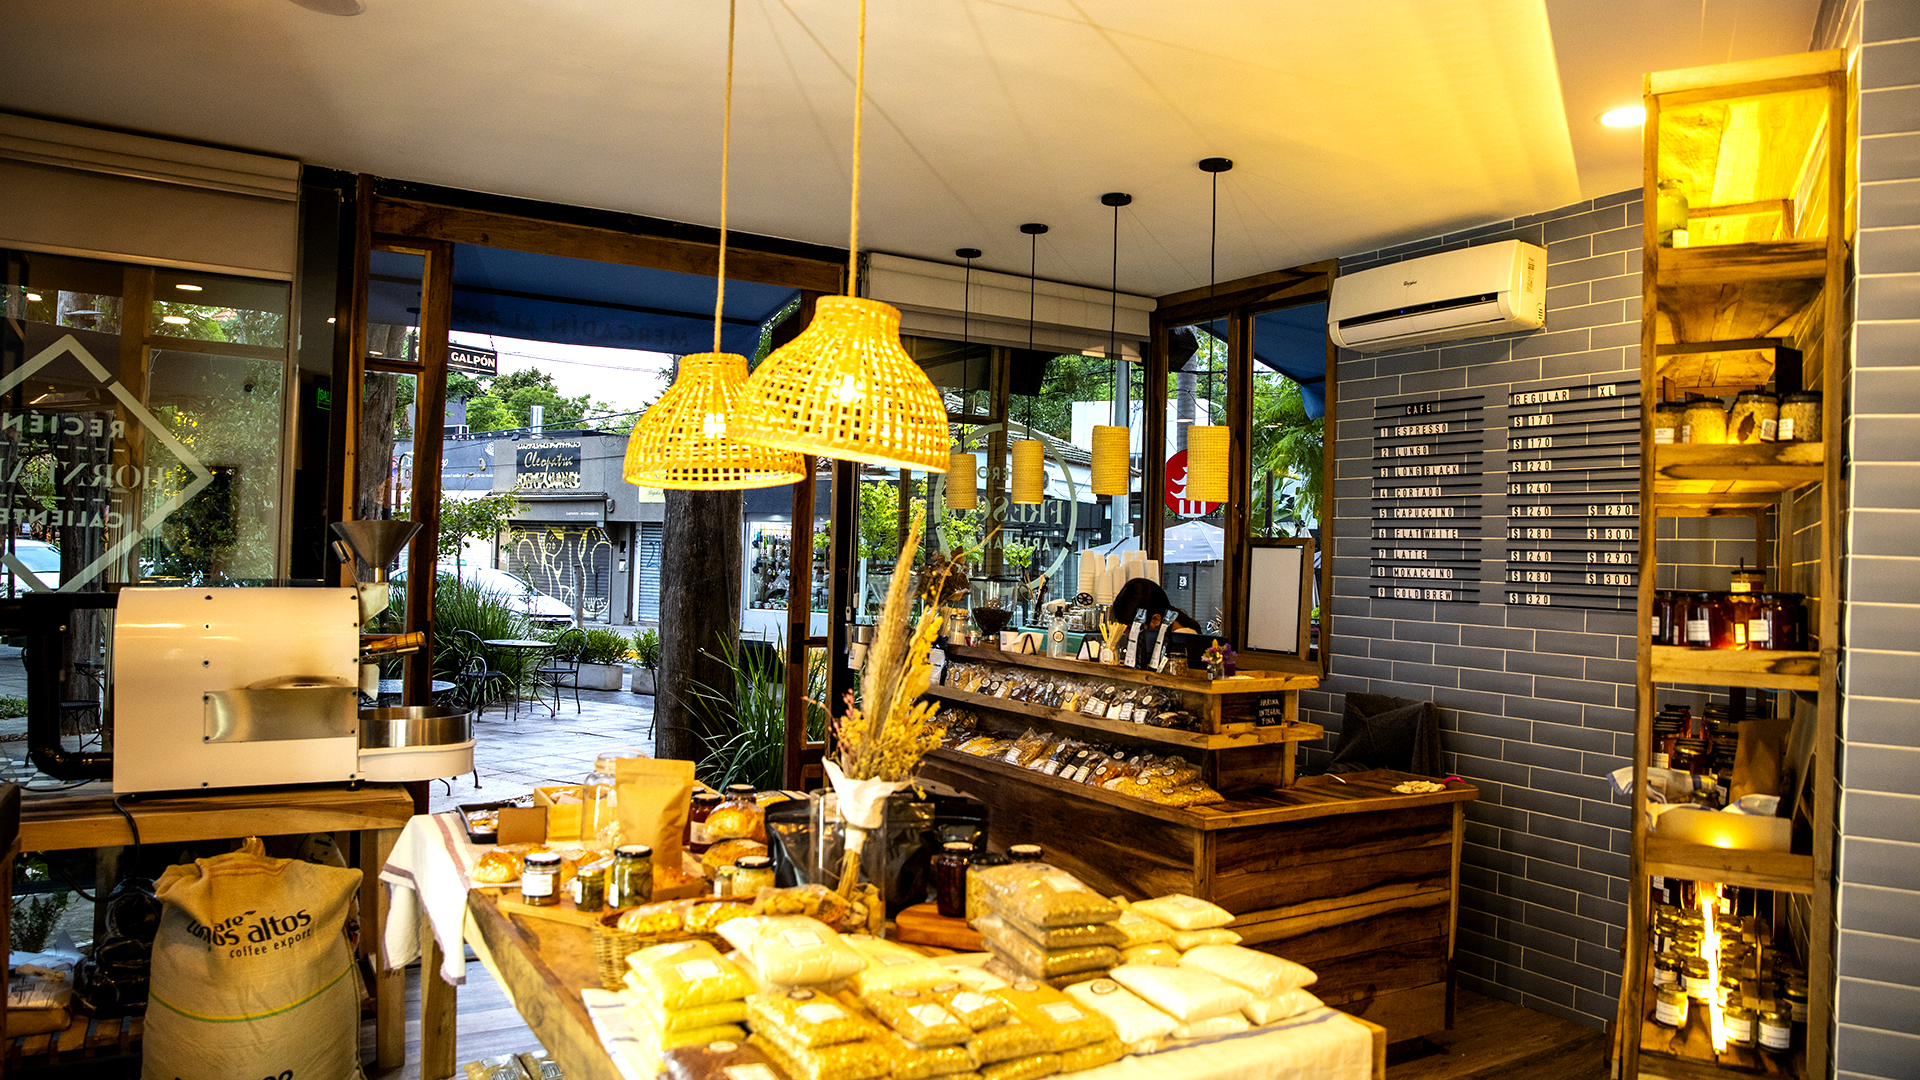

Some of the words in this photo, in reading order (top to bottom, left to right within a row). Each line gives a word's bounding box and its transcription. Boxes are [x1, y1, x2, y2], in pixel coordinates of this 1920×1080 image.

[450, 351, 496, 368] GALPÓN
[1514, 388, 1569, 404] REGULAR
[1599, 386, 1615, 397] XL
[1406, 403, 1432, 415] CAFE
[1531, 415, 1551, 426] 170
[1395, 423, 1448, 437] ESPRESSO
[1530, 437, 1550, 448] 170
[1396, 445, 1428, 456] LUNGO
[1396, 466, 1421, 477] LONG
[1424, 464, 1459, 475] BLACK
[1529, 461, 1550, 471] 220
[1395, 487, 1441, 497] CORTADO
[1528, 483, 1549, 493] 240
[1394, 507, 1454, 518] CAPUCCINO
[1529, 506, 1549, 516] 260
[1606, 505, 1631, 516] 290
[1395, 529, 1421, 539] FLAT
[1424, 529, 1458, 539] WHITE
[1528, 528, 1550, 538] 280
[1606, 529, 1631, 539] 300
[1394, 550, 1426, 560] LATTE
[1528, 551, 1549, 561] 260
[1606, 553, 1630, 564] 290
[1393, 568, 1453, 579] MOKACCINO
[1528, 571, 1549, 582] 280
[1605, 574, 1629, 585] 300
[1395, 589, 1420, 599] COLD
[1425, 590, 1453, 601] BREW
[1527, 594, 1548, 605] 320
[247, 909, 312, 943] altos
[229, 945, 268, 958] coffee
[273, 928, 312, 949] export
